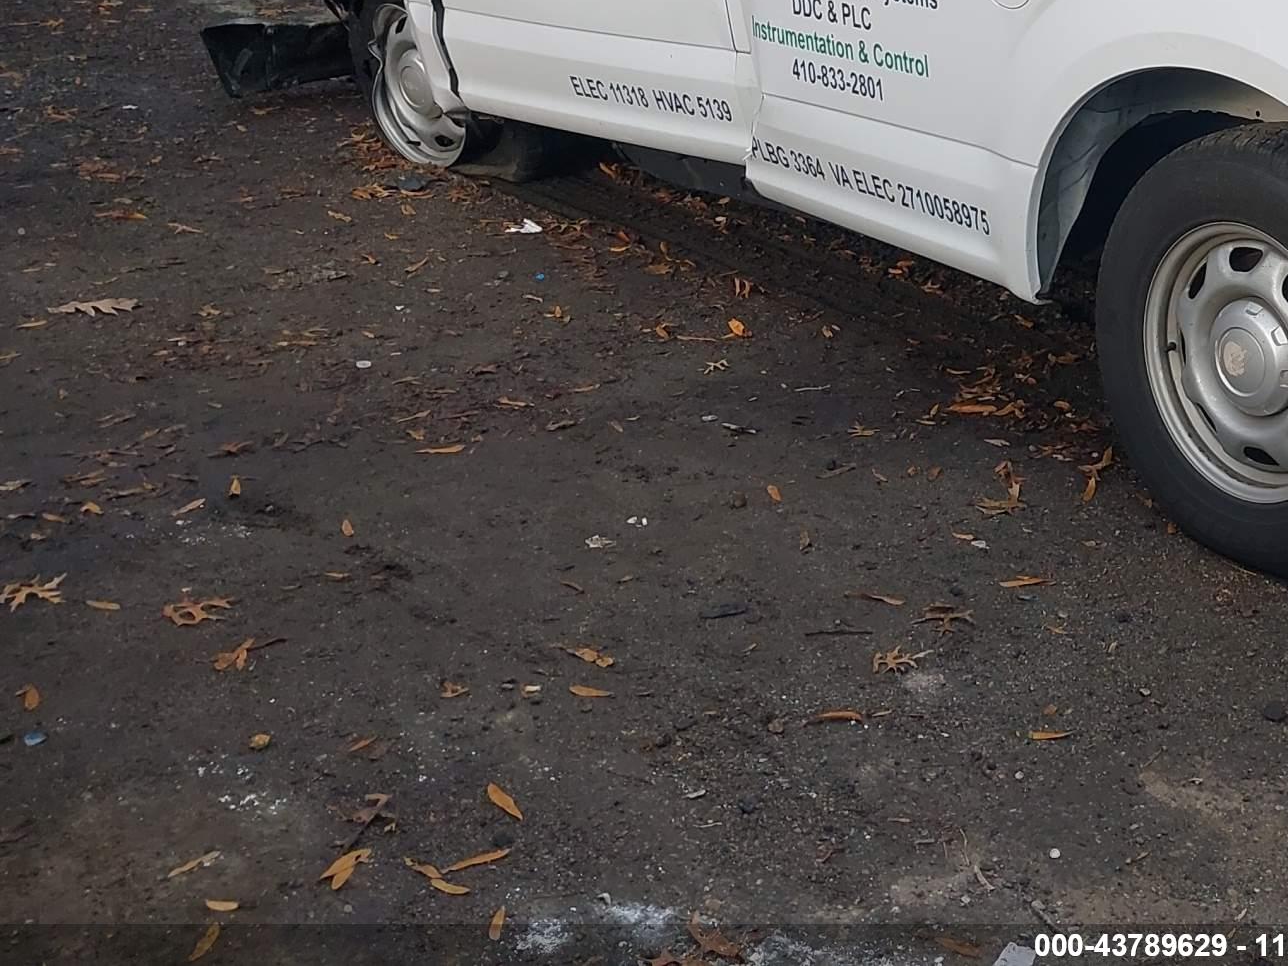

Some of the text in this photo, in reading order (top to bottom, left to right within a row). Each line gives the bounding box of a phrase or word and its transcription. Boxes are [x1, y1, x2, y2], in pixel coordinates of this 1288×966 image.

[828, 0, 838, 24] &
[842, 3, 872, 30] PLC
[752, 15, 929, 77] Instrumentation & Control
[570, 75, 733, 122] ELEC 11318 HVAC 5139
[792, 59, 883, 101] 410-833-2801
[752, 136, 991, 236] PLBG 3364 VA ELEC 2710058975
